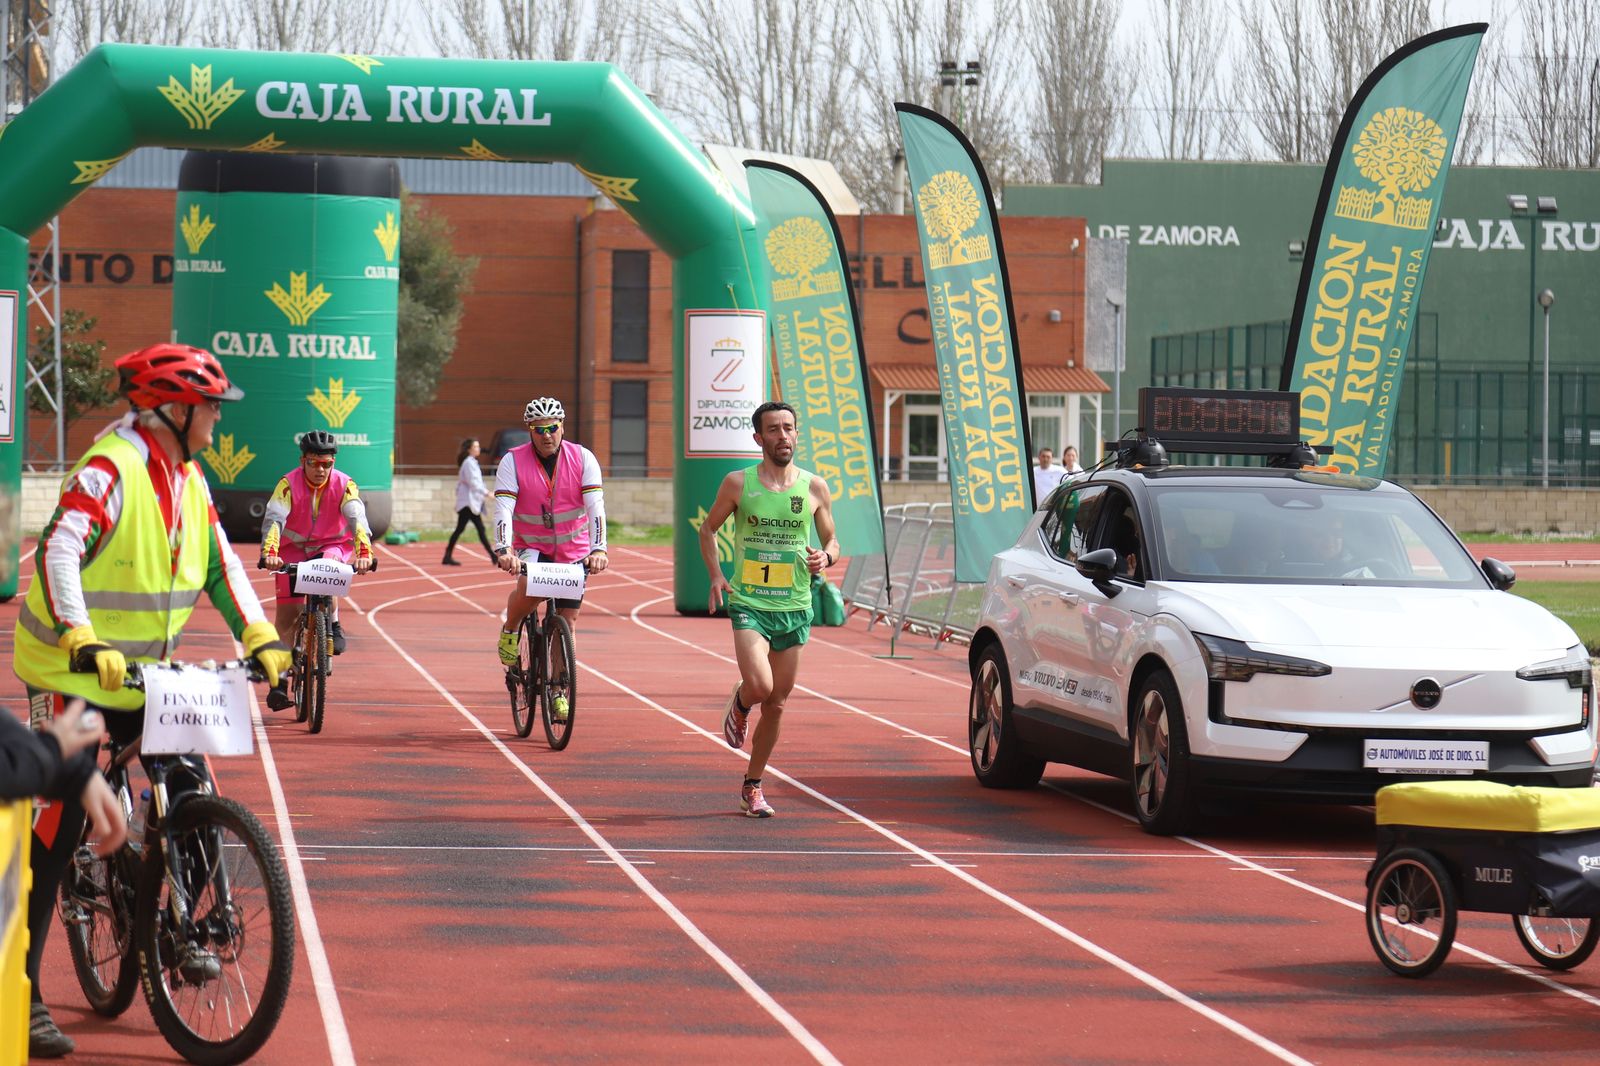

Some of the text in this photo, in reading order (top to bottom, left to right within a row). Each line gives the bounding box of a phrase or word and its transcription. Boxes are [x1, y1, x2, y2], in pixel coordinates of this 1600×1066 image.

[256, 81, 551, 126] CAJA RURAL
[1138, 225, 1240, 246] ZAMORA
[1341, 245, 1402, 406] RURAL
[212, 331, 377, 360] CAJA RURAL
[1364, 248, 1425, 468] VALLADOLID ZAMORA
[693, 416, 754, 430] ZAMOR
[312, 564, 340, 573] MEDIA
[541, 566, 570, 574] MEDIA
[761, 564, 770, 583] 1
[301, 575, 347, 586] MARATÓN
[755, 588, 769, 596] CAJA
[1034, 671, 1056, 687] VOLVO
[163, 693, 228, 707] FINAL DE
[159, 712, 230, 727] CARRERA
[1380, 748, 1427, 761] AUTOMÓVILES
[1428, 748, 1444, 761] JOSÉ
[1446, 751, 1455, 761] DE
[1457, 750, 1474, 762] DIOS,
[1475, 867, 1513, 883] MULE
